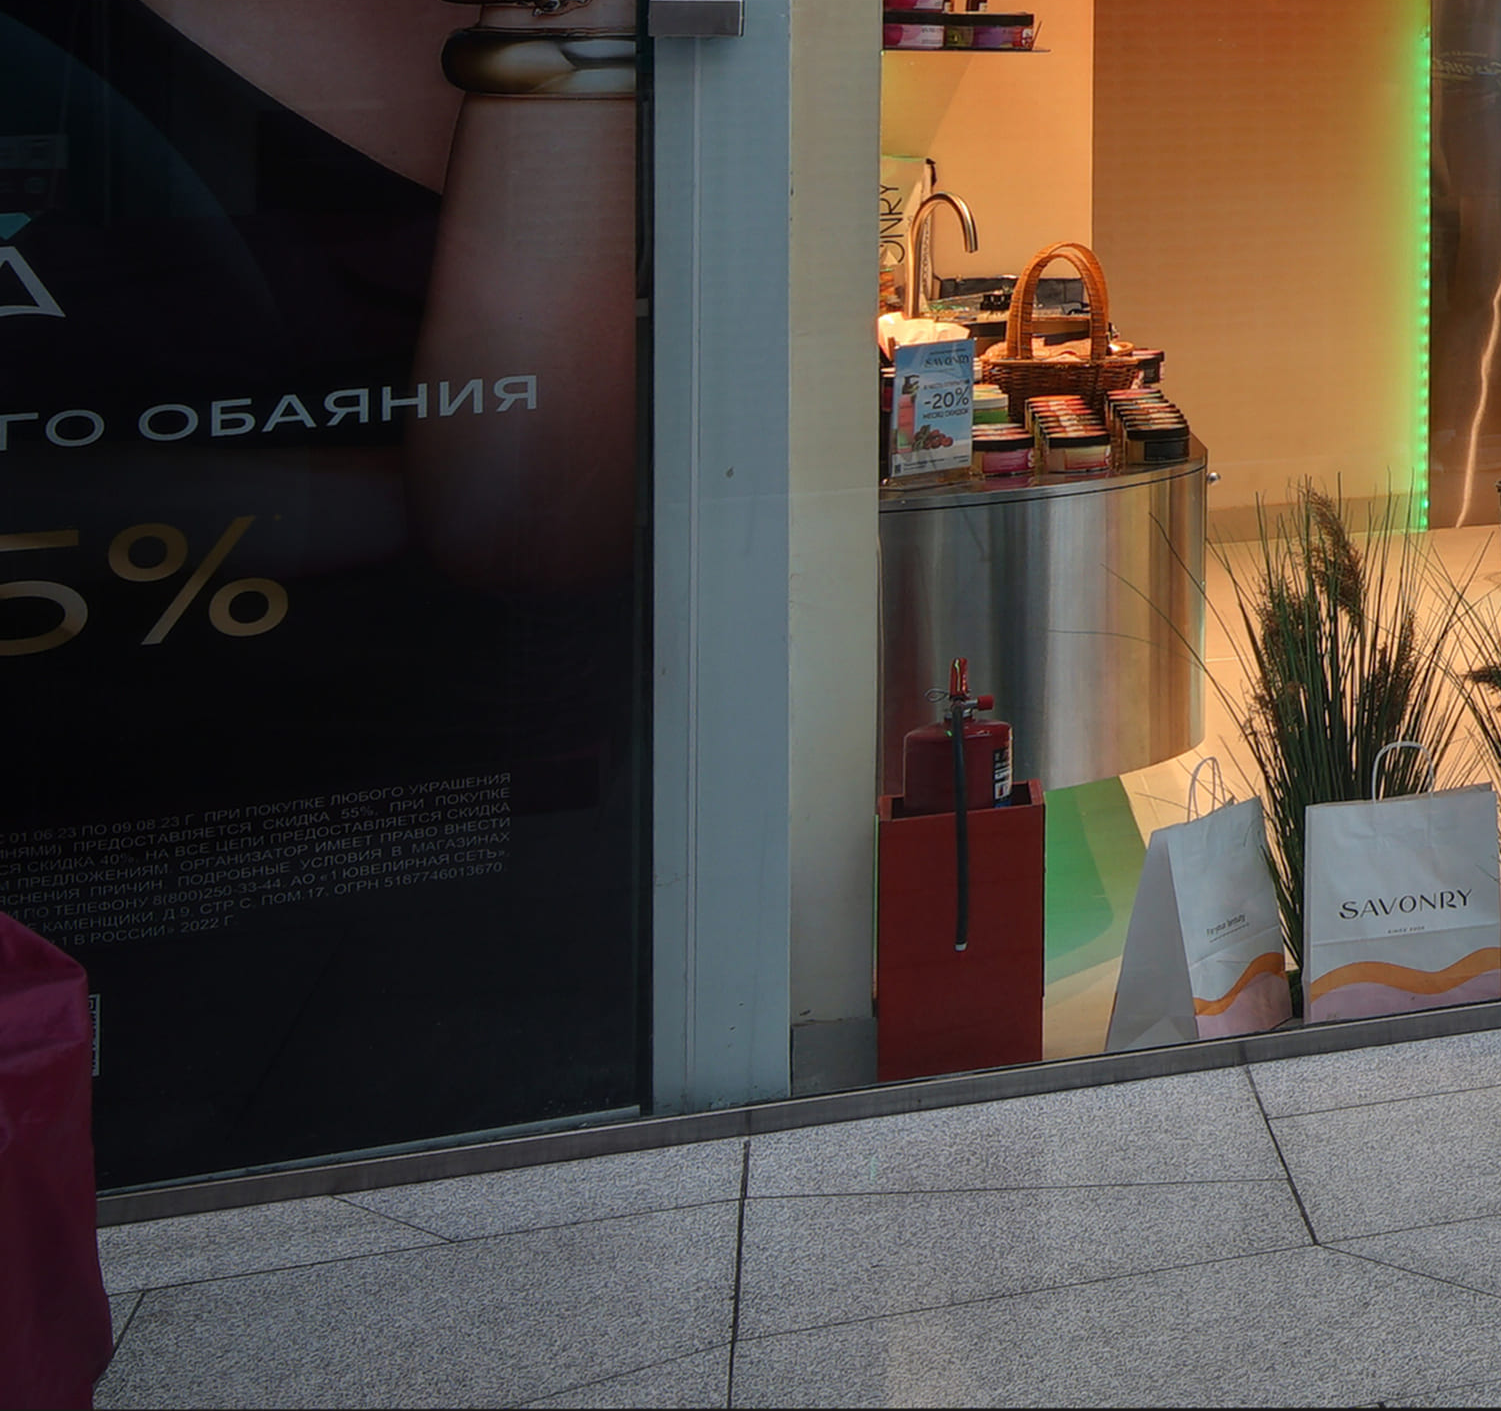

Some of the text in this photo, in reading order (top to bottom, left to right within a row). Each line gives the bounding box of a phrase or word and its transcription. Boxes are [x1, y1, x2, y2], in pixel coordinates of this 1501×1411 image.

[137, 374, 539, 442] ОБАЯНИЯ
[924, 387, 969, 410] -20%
[73, 821, 252, 853] ПРЕДОСТАВЛЯЕТСЯ
[263, 810, 330, 830] СКИДКА
[389, 798, 425, 813] ПРИ
[435, 787, 512, 808] ПОКУПКЕ
[81, 824, 108, 837] ПО
[204, 808, 241, 823] ПРИ
[245, 795, 326, 818] ПОКУПКЕ
[330, 785, 404, 806] ЛЮБОГО
[409, 772, 512, 794] УКРАШЕНИЯ
[27, 856, 95, 874] СКИДКА
[145, 847, 169, 861] НА
[174, 841, 209, 858] ВСЕ
[216, 835, 265, 854] ЦЕПИ
[270, 811, 442, 844] ПРЕДОСТАВЛЯЕТСЯ
[446, 800, 512, 820] СКИДКА
[178, 861, 291, 888] ПОДРОБНЫЕ
[300, 848, 383, 870] УСЛОВИЯ
[391, 846, 403, 858] В
[412, 832, 512, 855] МАГАЗИНАХ
[180, 844, 309, 873] ОРГАНИЗАТОР
[315, 835, 372, 853] ИМЕЕТ
[380, 825, 439, 845] ПРАВО
[445, 817, 512, 836] ВНЕСТИ
[54, 896, 147, 916] ТЕЛЕФОНУ
[290, 873, 316, 887] АО
[342, 854, 451, 879] ЮВЕЛИРНАЯ
[334, 880, 379, 896] ОГРН
[1339, 888, 1473, 921] SAVONRY
[74, 934, 86, 946] В
[180, 917, 219, 933] 2022
